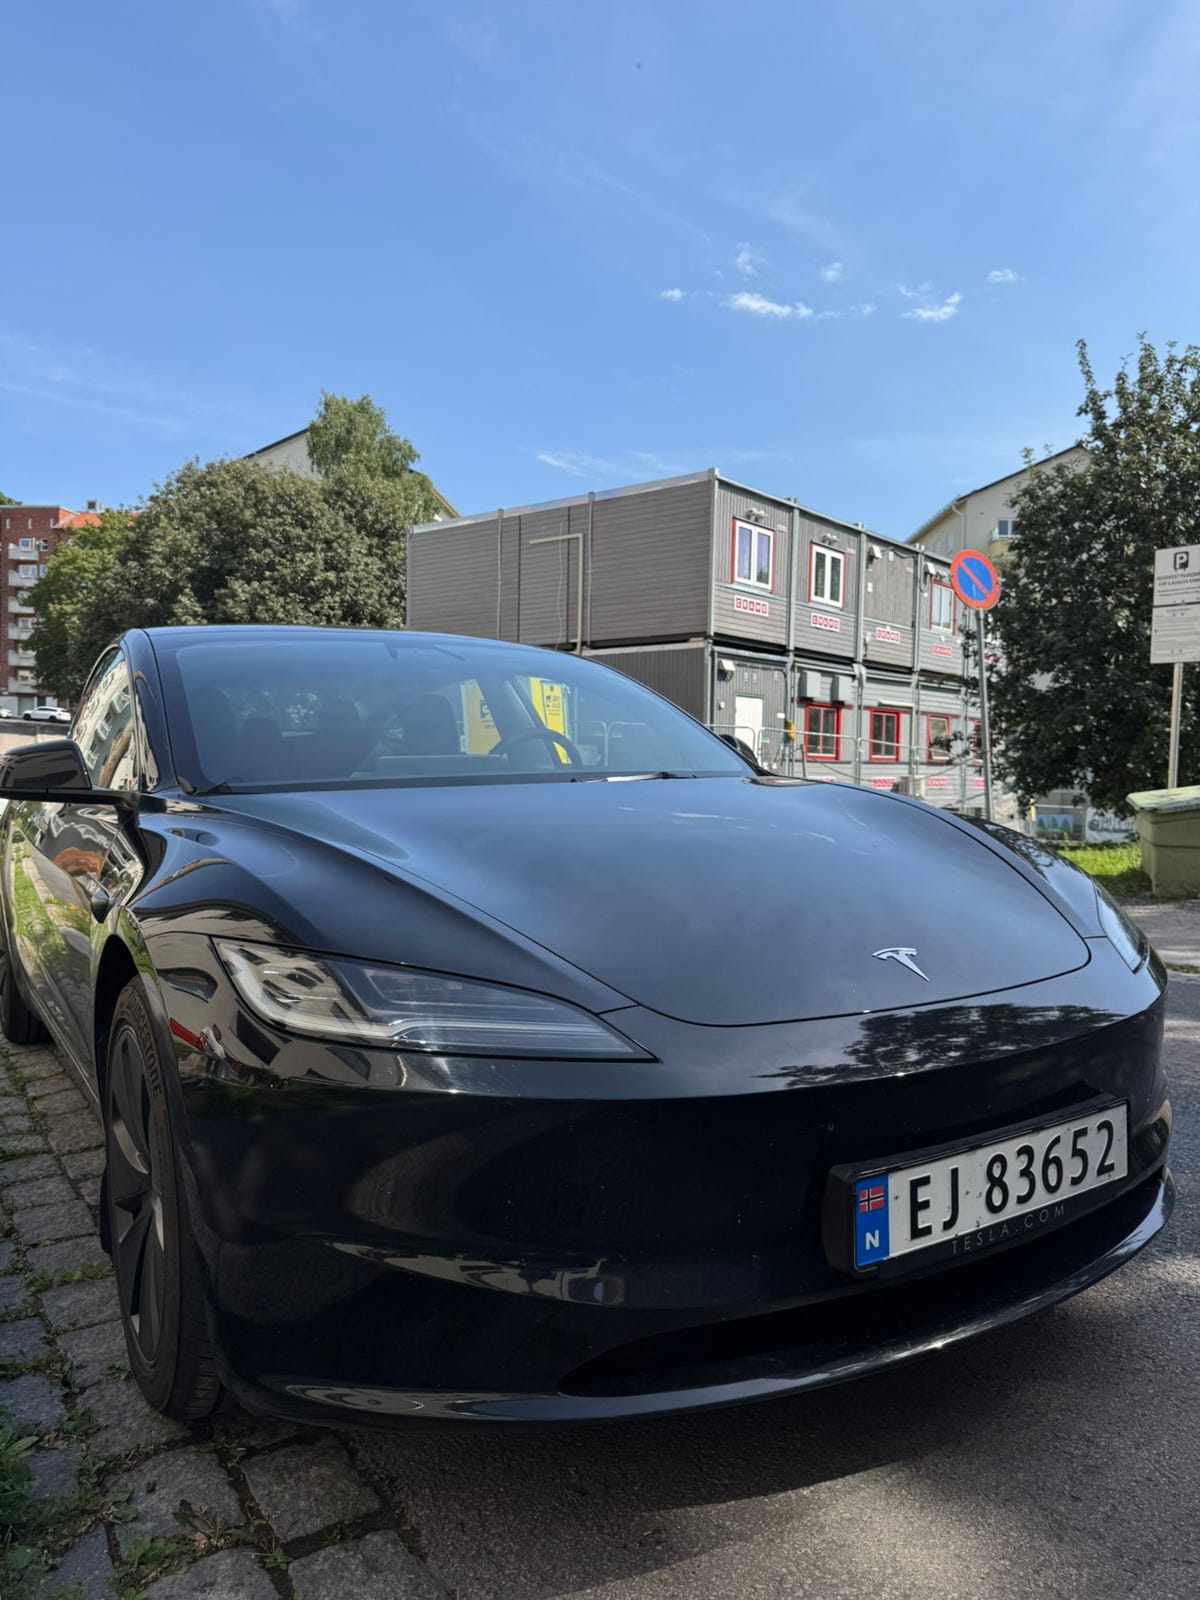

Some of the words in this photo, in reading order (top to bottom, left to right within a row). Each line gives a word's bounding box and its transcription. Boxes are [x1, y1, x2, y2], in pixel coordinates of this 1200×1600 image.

[126, 990, 163, 1097] BRIDGESTONE
[909, 1165, 960, 1241] EJ
[985, 1119, 1116, 1214] 83652
[865, 1229, 880, 1251] N
[951, 1204, 1066, 1255] TESLA.COM
